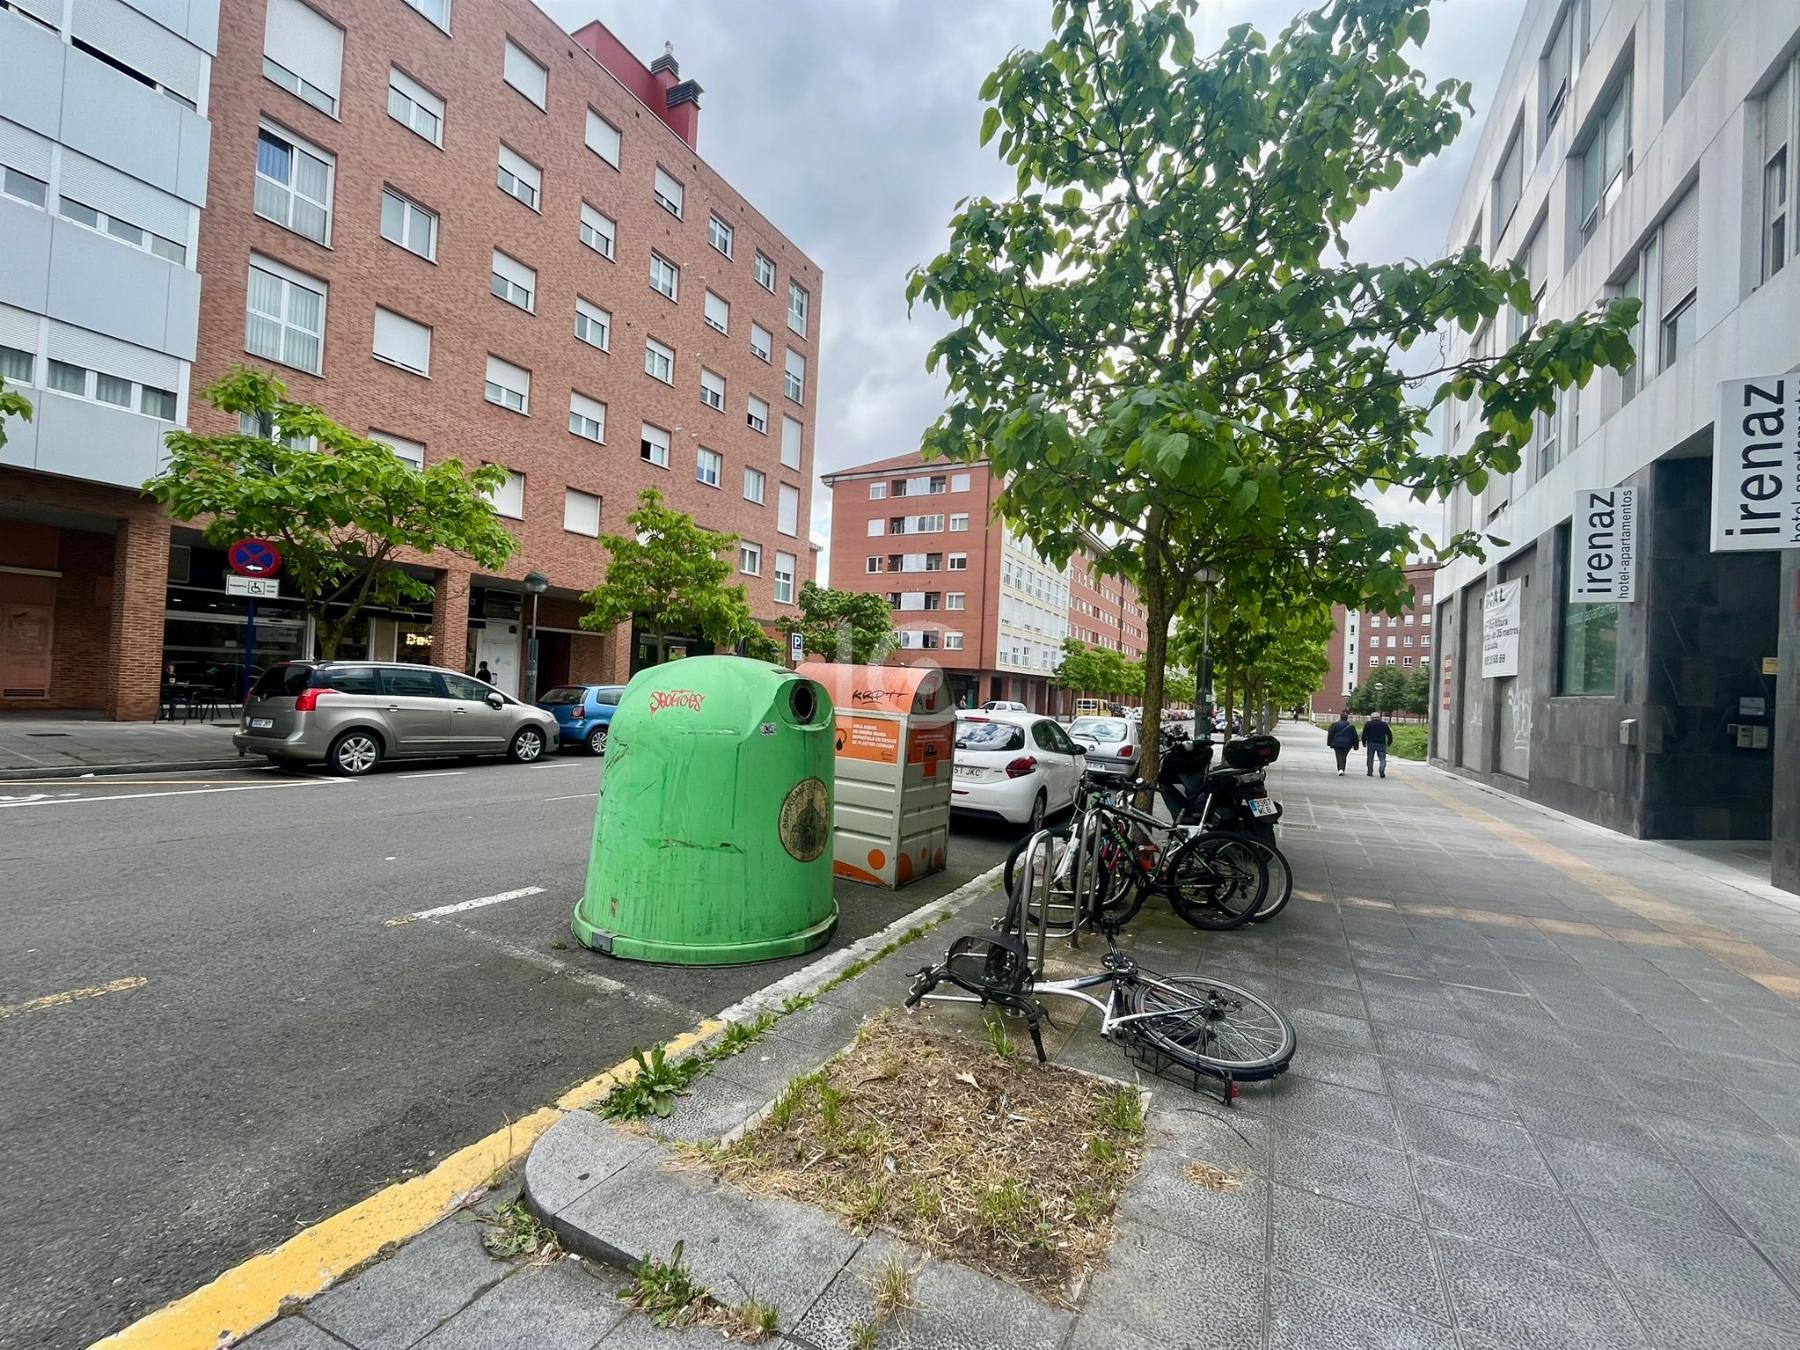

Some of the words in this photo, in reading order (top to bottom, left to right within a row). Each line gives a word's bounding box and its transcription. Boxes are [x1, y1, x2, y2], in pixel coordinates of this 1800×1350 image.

[1725, 380, 1785, 535] irenaz
[1578, 491, 1615, 593] irenaz
[1617, 489, 1633, 599] hotel-apartamentos
[966, 769, 981, 777] JKC
